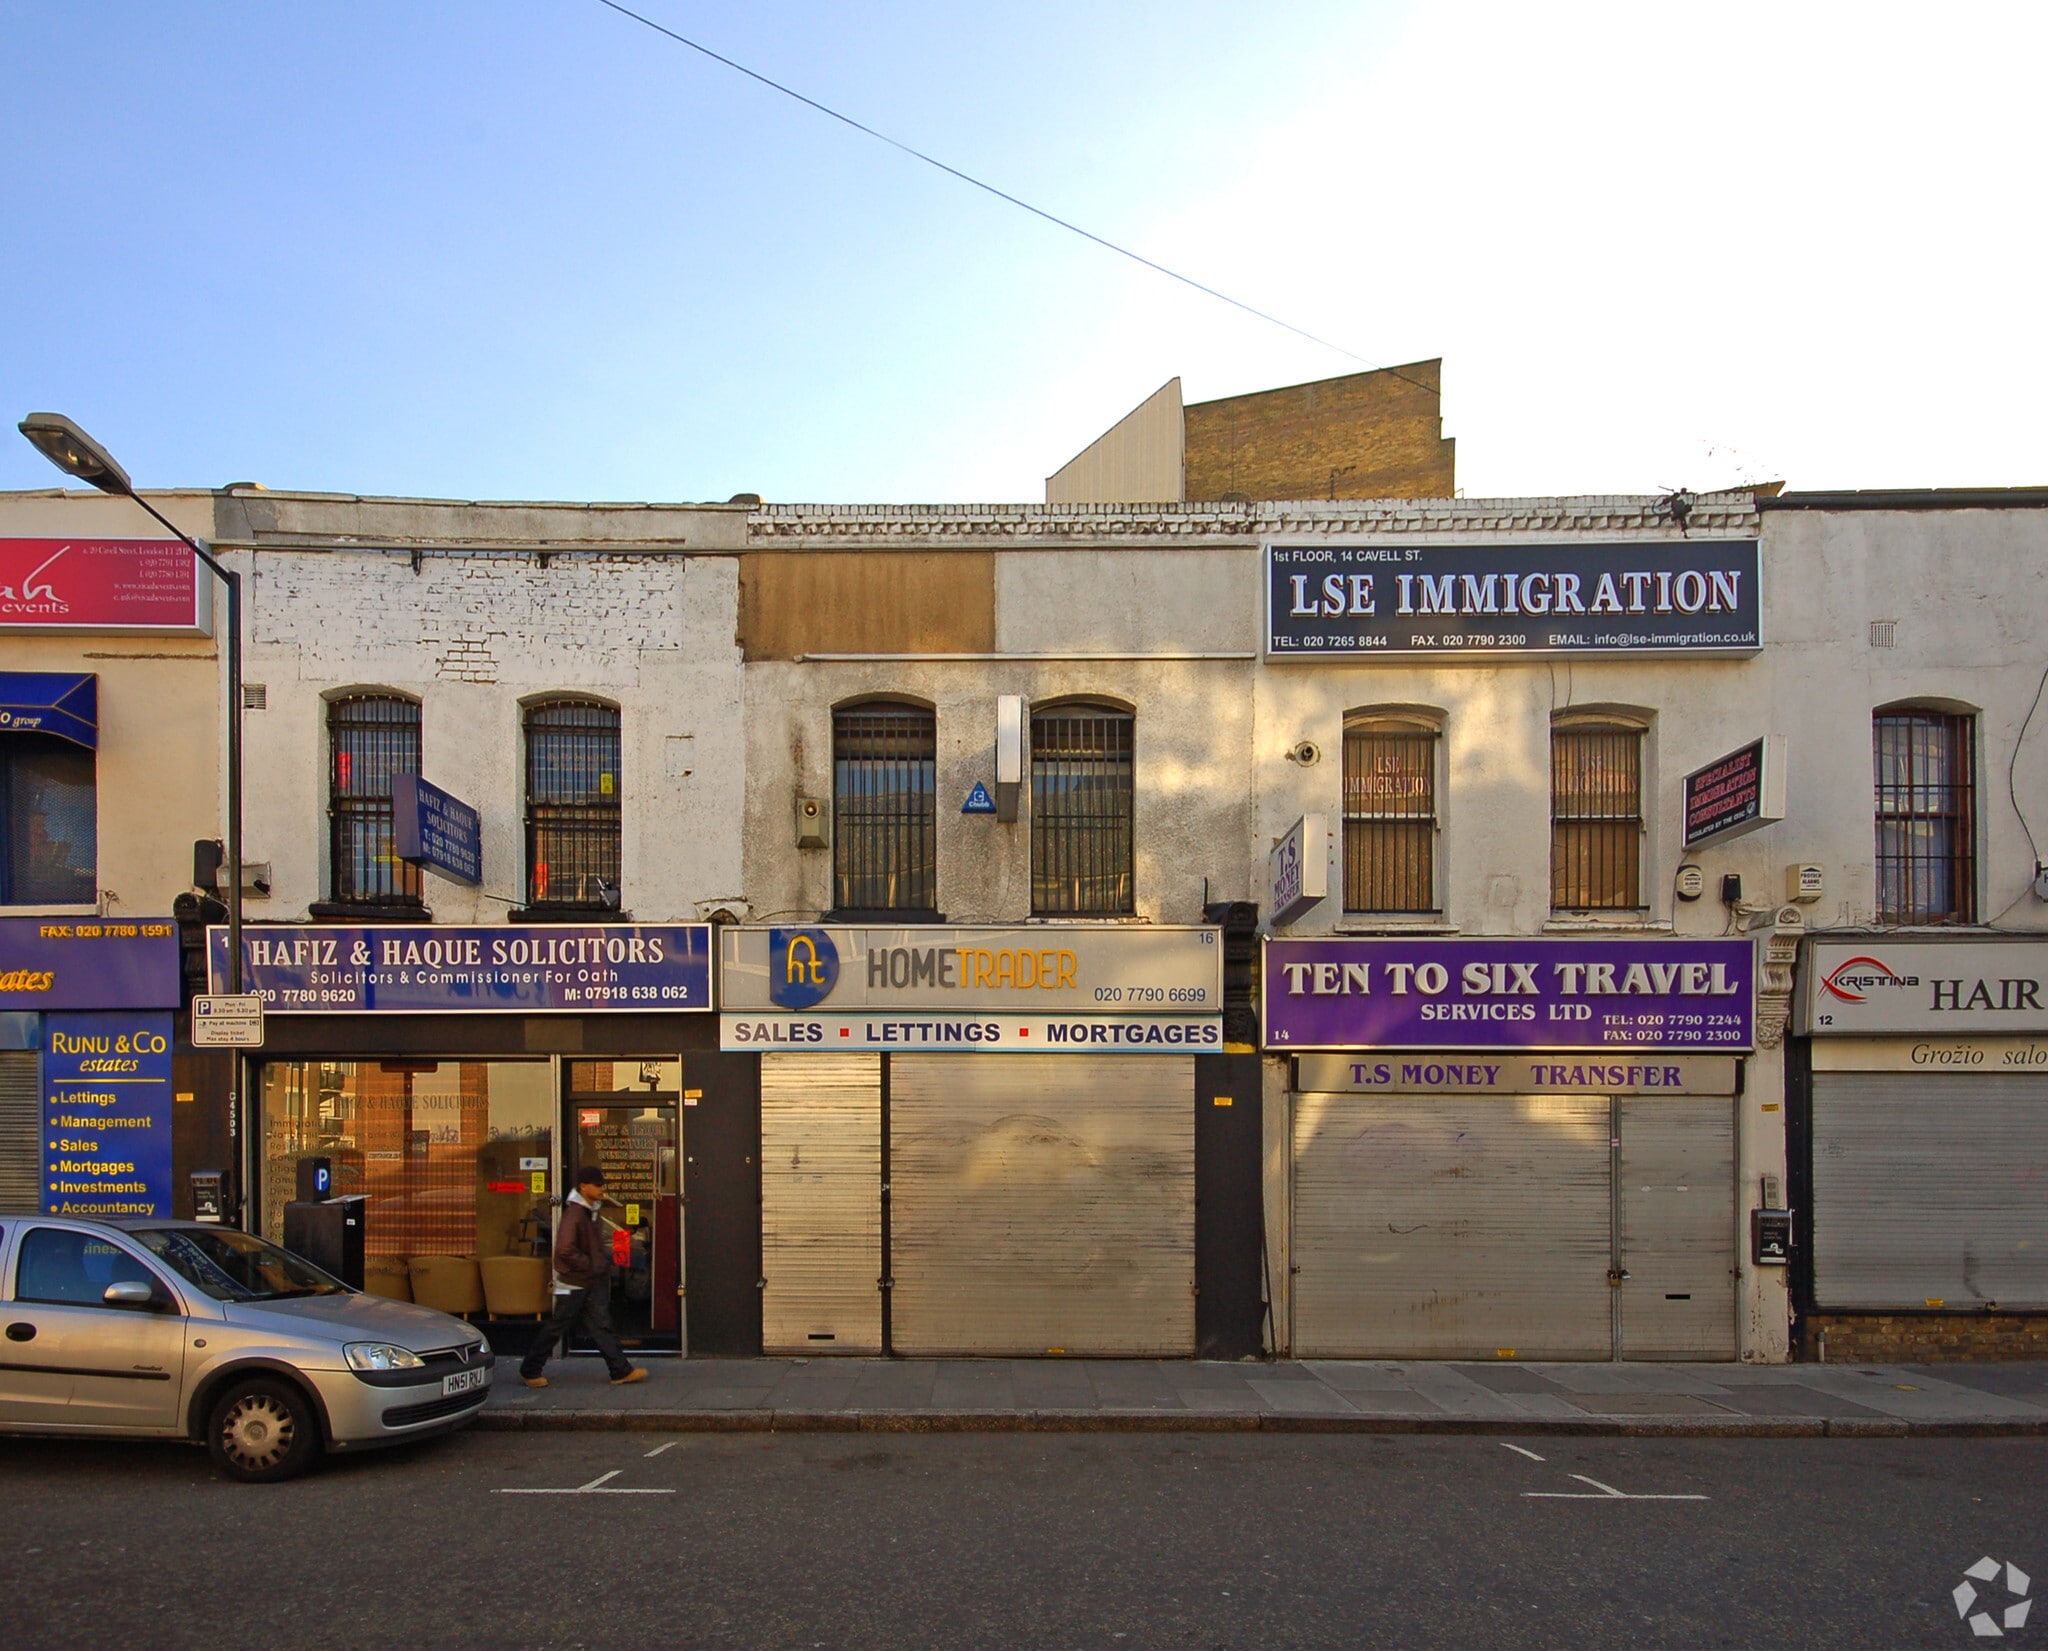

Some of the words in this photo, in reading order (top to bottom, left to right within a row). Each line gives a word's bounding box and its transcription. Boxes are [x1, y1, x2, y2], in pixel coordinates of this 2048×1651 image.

[1273, 551, 1289, 562] 1st
[1293, 551, 1336, 563] FLOOR,
[1341, 551, 1353, 561] 14
[1356, 550, 1401, 561] CAVELL
[1405, 550, 1423, 561] ST.
[1290, 574, 1375, 617] LSE
[1396, 571, 1741, 617] IMMIGRATION
[2, 602, 69, 613] events
[1273, 636, 1299, 647] TEL:
[1303, 636, 1324, 647] 020
[1328, 636, 1355, 647] 7265
[1359, 636, 1387, 647] 8844
[1411, 635, 1438, 646] FAX.
[1443, 635, 1463, 646] 020
[1467, 635, 1494, 646] 7790
[1499, 634, 1526, 646] 2300
[1549, 634, 1590, 645] EMAIL:
[1594, 631, 1755, 646] info@lse-immigration.co.uk
[12, 717, 41, 728] group
[418, 788, 441, 813] HAFIZ
[443, 802, 449, 816] &
[450, 806, 473, 830] HAQUE
[426, 810, 468, 844] SOLICITORS
[431, 832, 444, 847] 020
[1274, 863, 1299, 900] MONEY
[40, 926, 73, 938] FAX:
[76, 925, 100, 937] 020
[104, 925, 137, 937] 7780
[141, 925, 173, 937] 1591
[1199, 933, 1214, 944] 16
[252, 940, 337, 966] HAFIZ
[350, 940, 371, 966] &
[383, 940, 481, 968] HAQUE
[492, 938, 664, 965] SOLICITORS
[311, 971, 393, 984] Solicitors
[400, 971, 410, 984] &
[417, 970, 539, 984] Commissioner
[546, 970, 571, 983] For
[578, 969, 618, 982] Oath
[1282, 963, 1370, 995] TEN
[1384, 963, 1449, 995] TO
[1461, 963, 1540, 995] SIX
[1554, 963, 1739, 995] TRAVEL
[283, 989, 317, 1002] 7780
[321, 989, 356, 1002] 9620
[565, 988, 581, 1000] M:
[585, 986, 627, 999] 07918
[632, 986, 657, 999] 638
[662, 986, 687, 999] 062
[1094, 988, 1122, 1001] 020
[1128, 988, 1164, 1001] 7790
[1169, 988, 1206, 1001] 6699
[1929, 979, 2045, 1010] HAIR
[1421, 1004, 1535, 1020] SERVICES
[1549, 1004, 1592, 1020] LTD
[1603, 1015, 1633, 1025] TEL:
[1637, 1015, 1664, 1025] 020
[1669, 1015, 1703, 1025] 7790
[1707, 1014, 1742, 1025] 2244
[1819, 1015, 1833, 1025] 12
[735, 1023, 823, 1042] SALES
[866, 1023, 1000, 1042] LETTINGS
[1047, 1024, 1218, 1043] MORTGAGES
[1274, 1030, 1290, 1041] 14
[1603, 1031, 1632, 1041] FAX:
[1637, 1031, 1663, 1041] 020
[1668, 1031, 1701, 1041] 7790
[1706, 1031, 1741, 1041] 2300
[115, 1035, 129, 1053] &
[1911, 1044, 1984, 1064] Grožio
[2003, 1044, 2047, 1064] salo
[80, 1058, 139, 1072] estates
[1349, 1064, 1391, 1084] T.S
[1401, 1065, 1501, 1085] MONEY
[1530, 1065, 1683, 1086] TRANSFER
[60, 1092, 116, 1106] Lettings
[60, 1115, 151, 1130] Management
[60, 1139, 98, 1151] Sales
[60, 1160, 135, 1175] Mortgages
[60, 1181, 147, 1193] Investments
[319, 1168, 328, 1191] P
[61, 1202, 155, 1216] Accountancy
[448, 1373, 468, 1392] HN51
